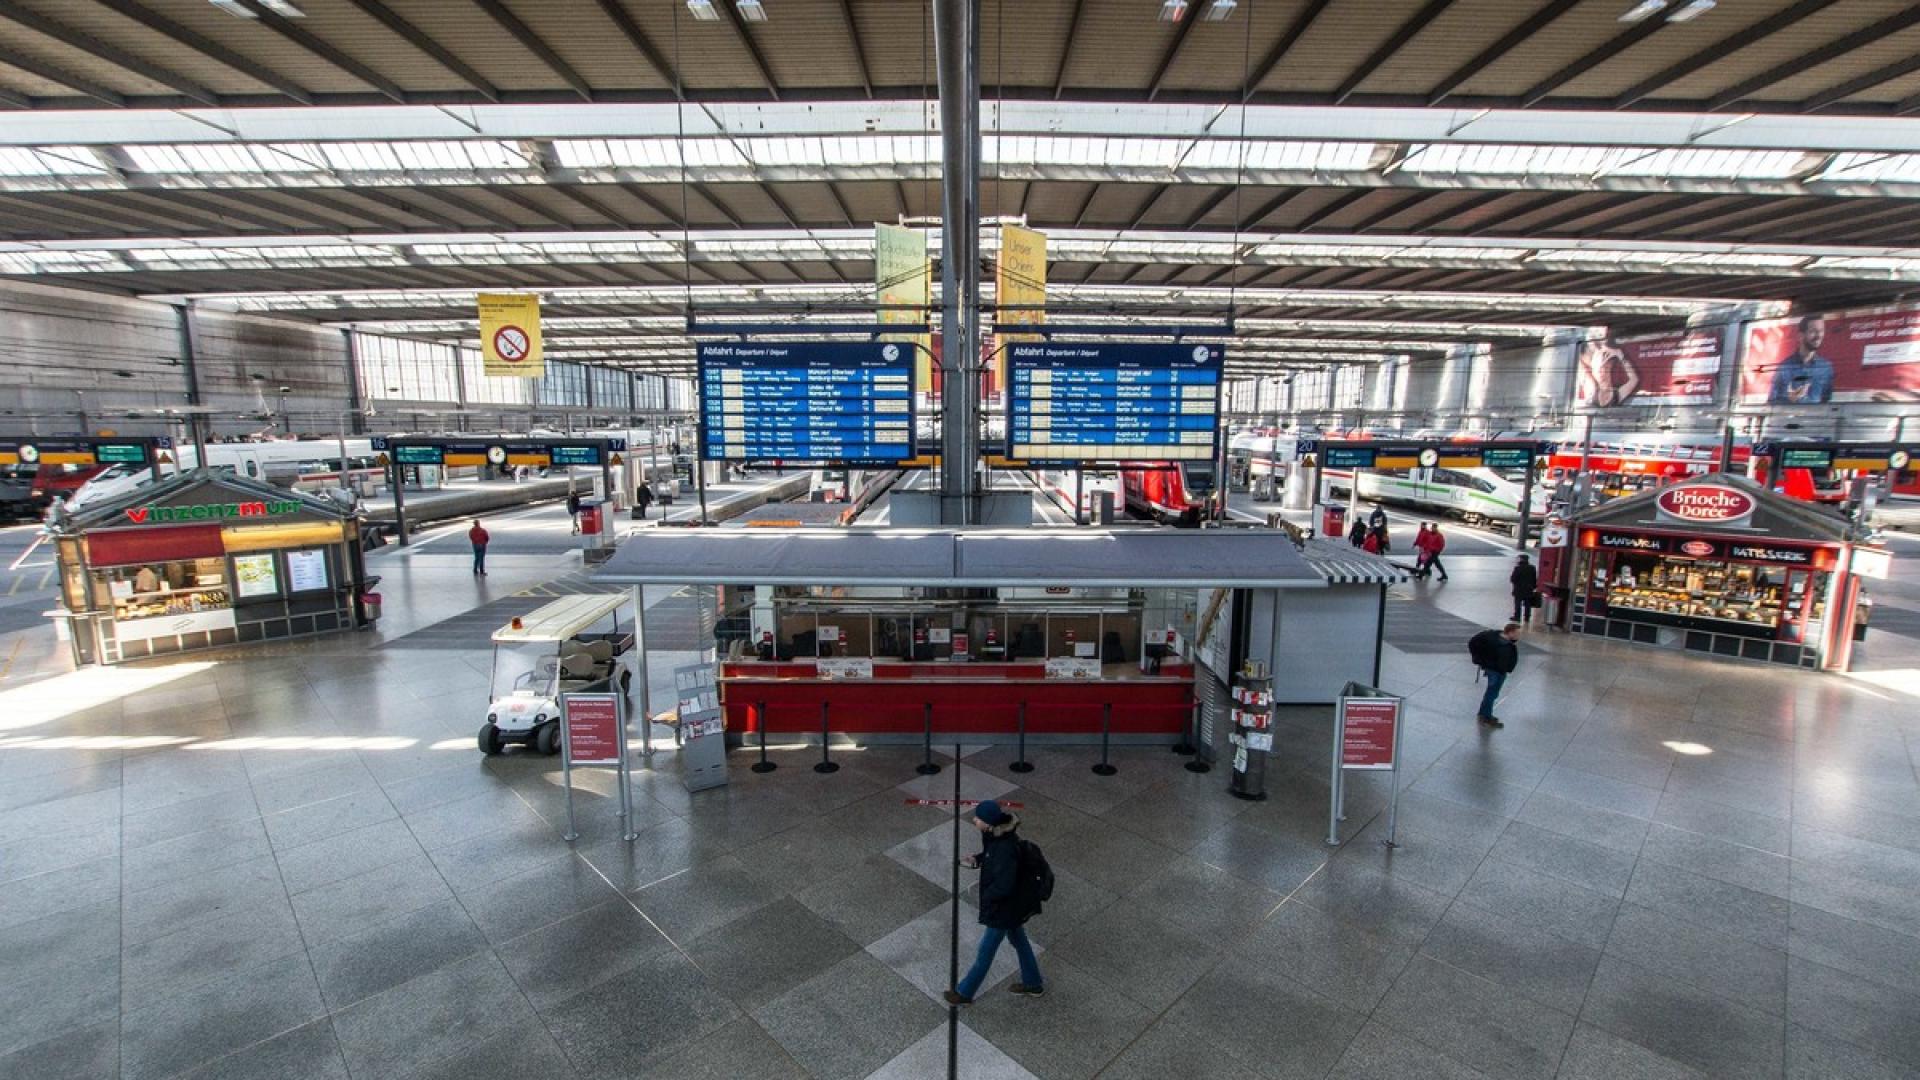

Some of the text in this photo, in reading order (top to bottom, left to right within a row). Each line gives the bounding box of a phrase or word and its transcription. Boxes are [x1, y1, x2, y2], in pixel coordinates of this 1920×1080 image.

[703, 346, 733, 356] Abfahrt
[735, 348, 764, 357] Departure
[1014, 347, 1044, 356] Abfahrt
[1046, 348, 1076, 358] Departure
[157, 437, 171, 447] 15
[373, 438, 386, 449] 16
[610, 439, 623, 449] 17
[1299, 440, 1313, 452] 20
[1672, 490, 1741, 508] Brioche
[1679, 503, 1729, 518] Dorée
[1603, 535, 1660, 549] SANDWICH
